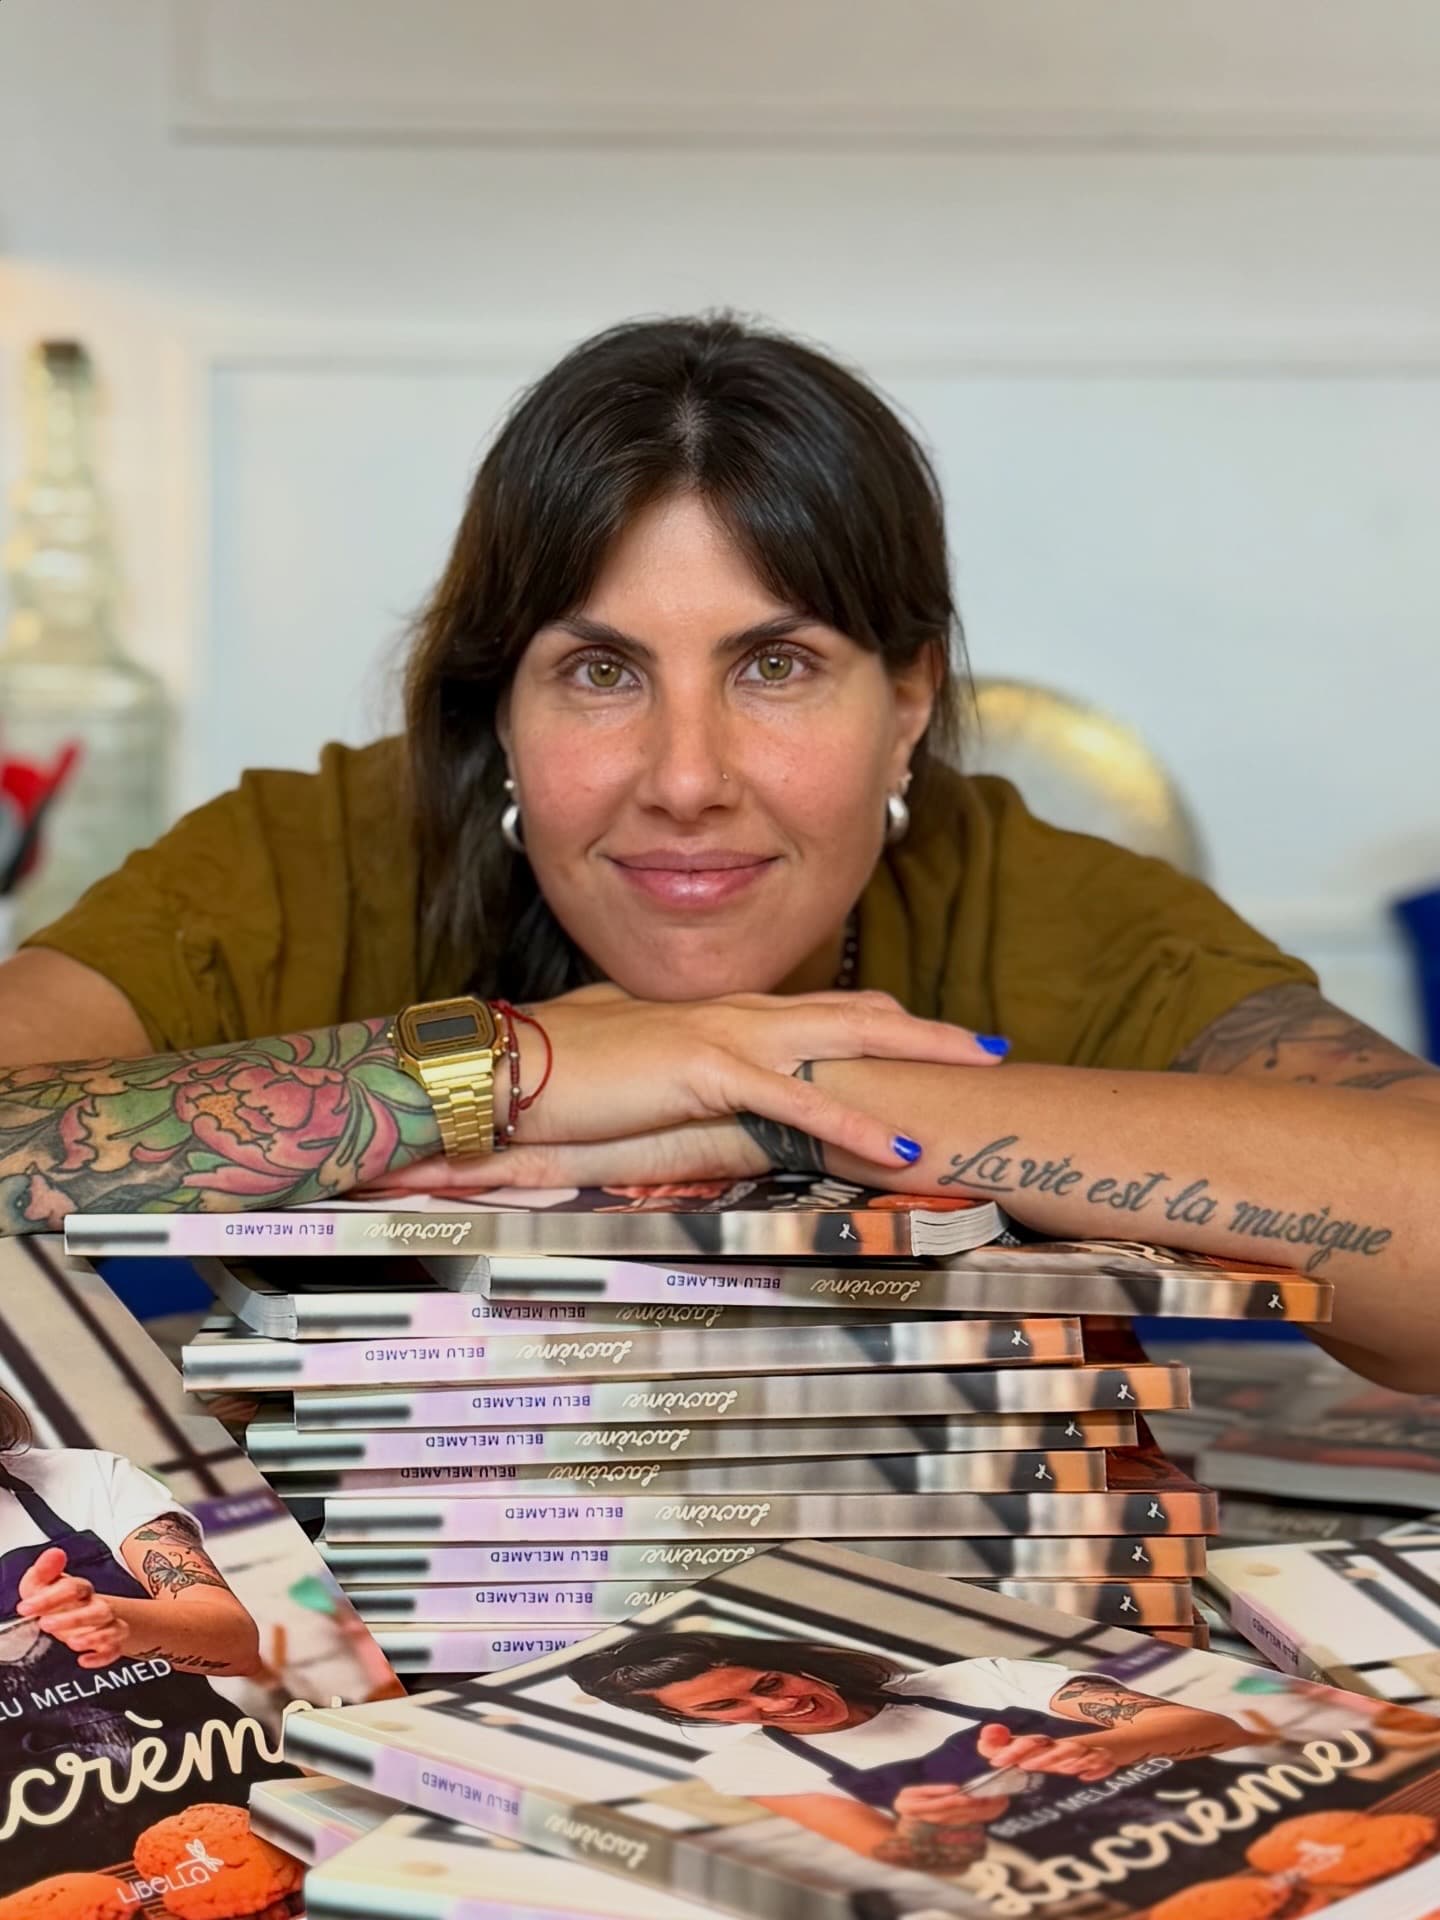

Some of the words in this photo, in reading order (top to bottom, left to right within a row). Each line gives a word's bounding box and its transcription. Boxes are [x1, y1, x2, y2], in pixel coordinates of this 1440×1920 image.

[938, 1135, 1019, 1192] La
[1021, 1156, 1083, 1197] vie
[1087, 1172, 1170, 1212] est
[1163, 1179, 1216, 1226] la
[1227, 1206, 1393, 1273] musique
[226, 1224, 293, 1236] MELAMED
[300, 1224, 334, 1235] BELU
[364, 1221, 472, 1245] Lacrème
[666, 1275, 738, 1288] MELAMED
[743, 1277, 781, 1289] BELU
[811, 1277, 921, 1301] Lacrème
[472, 1306, 542, 1318] MELAMED
[550, 1306, 585, 1318] BELU
[365, 1349, 440, 1361] MELAMED
[448, 1347, 485, 1359] BELU
[517, 1340, 632, 1366] Lacrème
[472, 1396, 546, 1408] MELAMED
[553, 1395, 590, 1407] BELU
[622, 1390, 737, 1415] Lacrème
[426, 1434, 499, 1447] MELAMED
[506, 1433, 544, 1445] BELU
[575, 1429, 691, 1452] Lacrème
[401, 1467, 473, 1479] MELAMED
[479, 1466, 517, 1478] BELU
[548, 1464, 661, 1487] Lacrème
[505, 1507, 578, 1519] MELAMED
[585, 1506, 623, 1518] BELU
[656, 1503, 770, 1527] Lacrème
[491, 1551, 564, 1563] MELAMED
[571, 1550, 608, 1561] BELU
[476, 1592, 549, 1603] MELAMED
[555, 1591, 592, 1602] BELU
[492, 1640, 566, 1652] MELAMED
[31, 1658, 171, 1709] MELAMED
[0, 1696, 342, 1840] crèm
[422, 1771, 482, 1802] MELAMED
[988, 1808, 1061, 1837] BELU
[1055, 1757, 1174, 1812] MELAMED
[487, 1795, 520, 1816] BELU
[967, 1730, 1372, 1916] Lacrème
